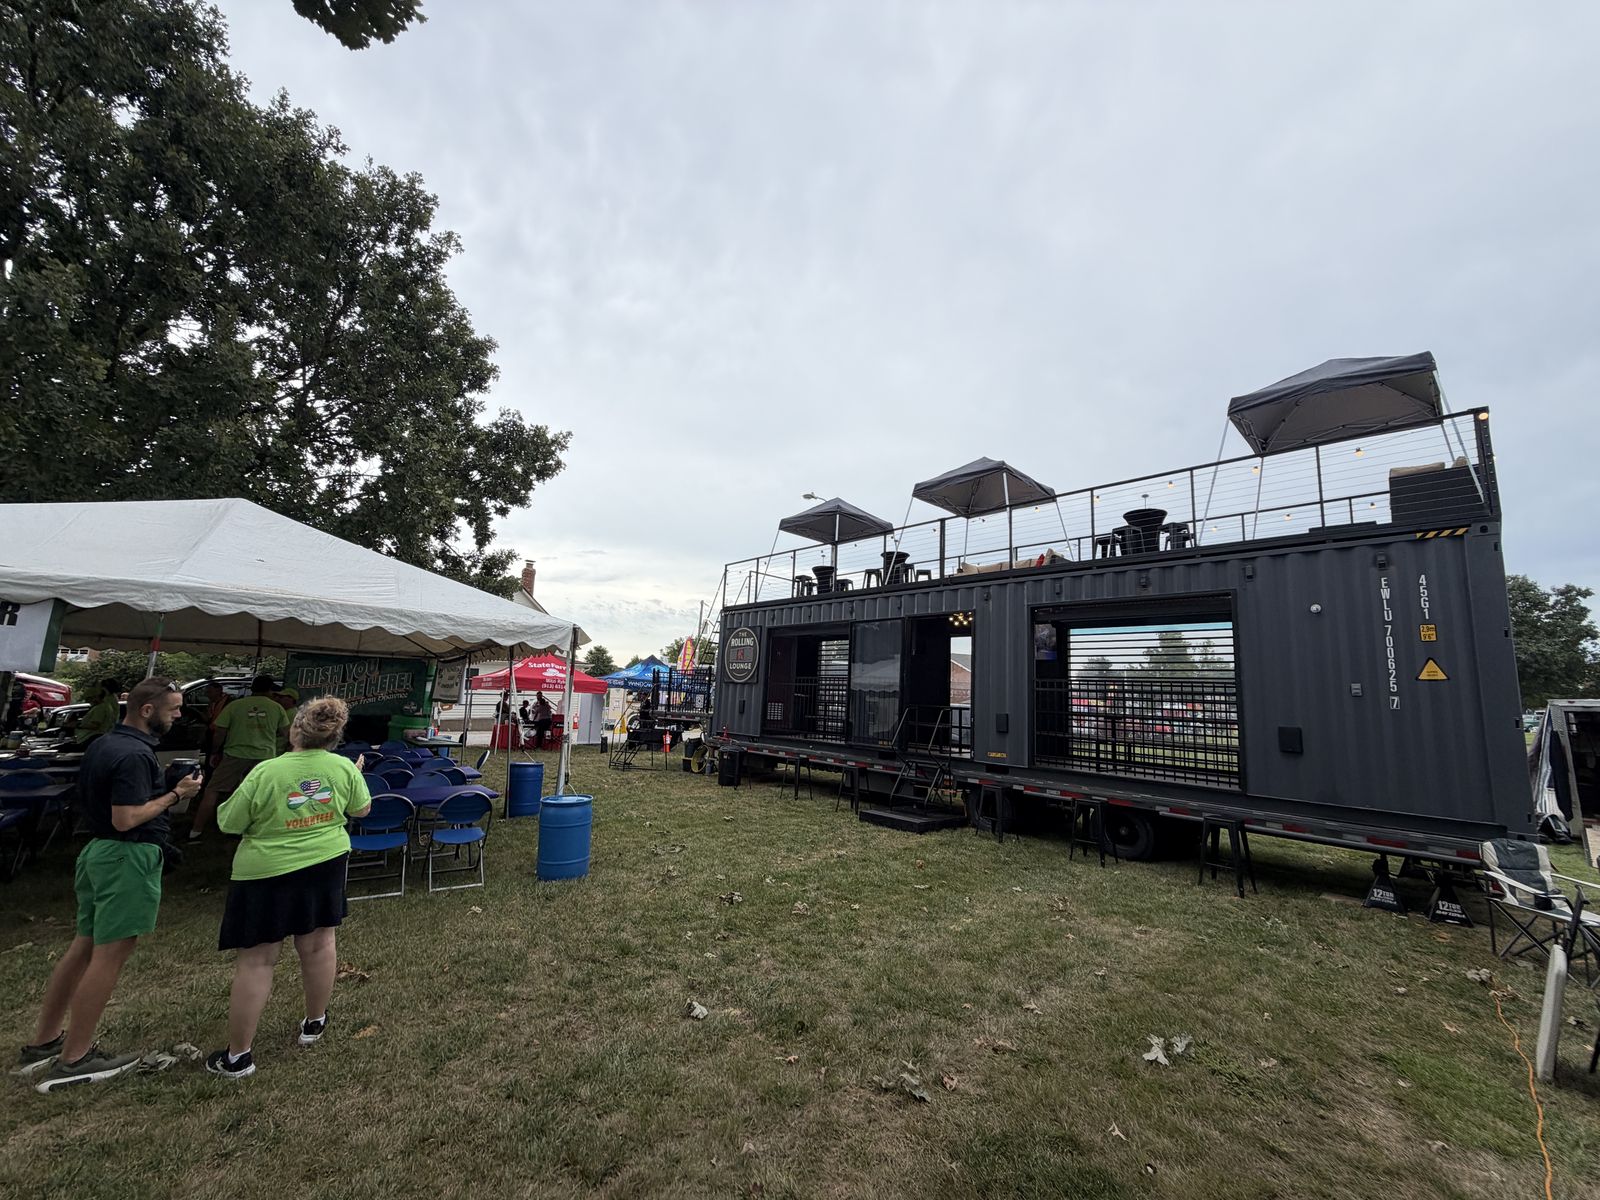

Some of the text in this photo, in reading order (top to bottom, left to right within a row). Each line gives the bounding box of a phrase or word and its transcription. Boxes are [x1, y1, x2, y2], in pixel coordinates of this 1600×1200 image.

[1418, 574, 1430, 620] 45G1
[730, 637, 754, 647] ROLLING
[297, 658, 380, 688] IRISH YOU
[729, 662, 752, 670] LOUNGE
[366, 672, 414, 697] HERE!
[285, 811, 335, 829] VOLUNTEER
[1372, 888, 1394, 898] 12 TON
[1438, 900, 1461, 911] 12 TON
